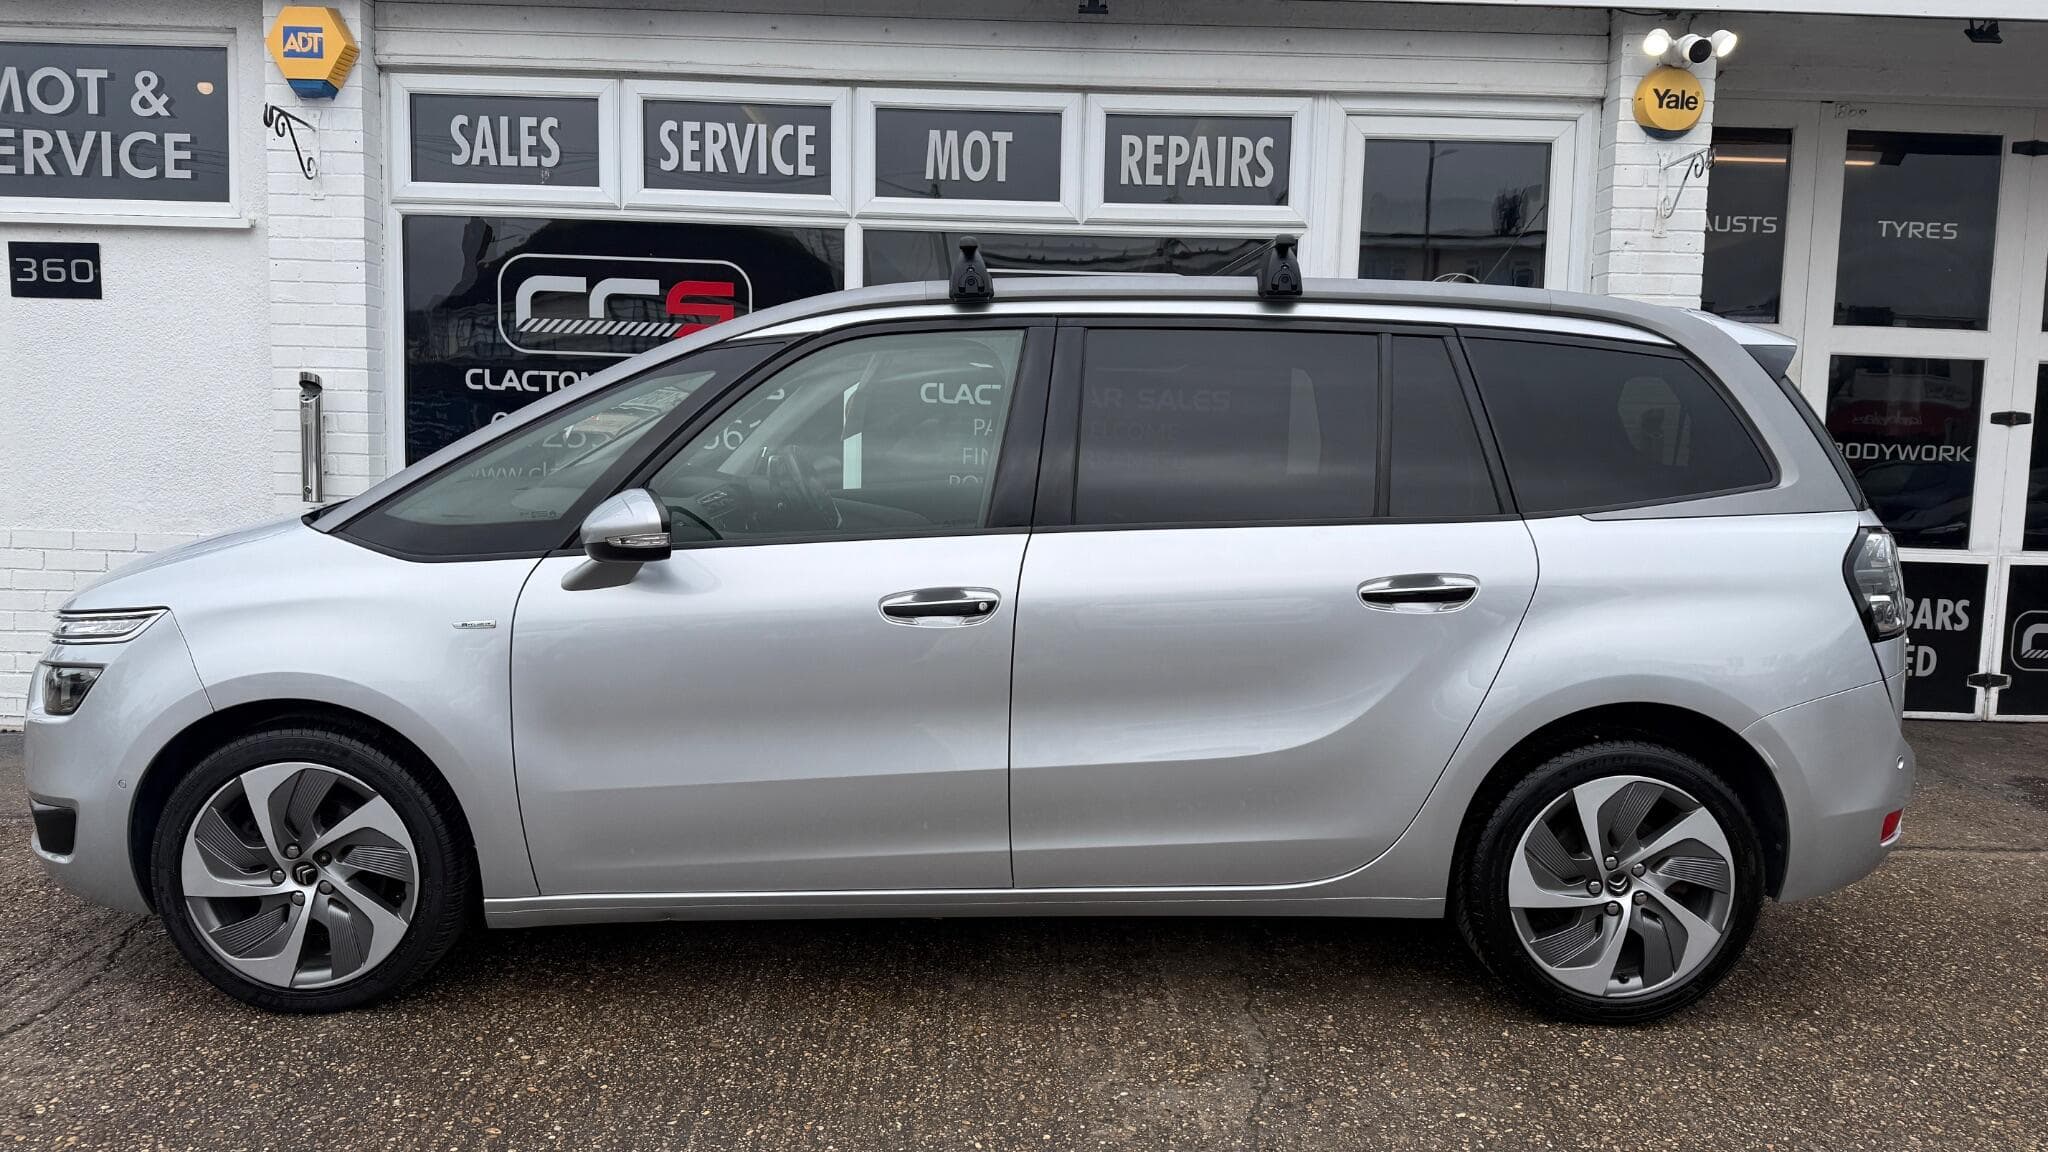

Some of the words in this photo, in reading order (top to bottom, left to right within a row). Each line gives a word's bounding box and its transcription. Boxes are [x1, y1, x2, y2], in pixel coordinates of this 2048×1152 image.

[283, 31, 324, 53] ADT
[130, 70, 171, 117] &
[1653, 88, 1699, 110] Yale
[450, 114, 561, 168] SALES
[659, 119, 816, 177] SERVICE
[925, 129, 1013, 182] MOT
[1120, 134, 1275, 188] REPAIRS
[1878, 220, 1959, 240] TYRES
[15, 257, 96, 284] 360
[465, 368, 597, 393] CLACTO
